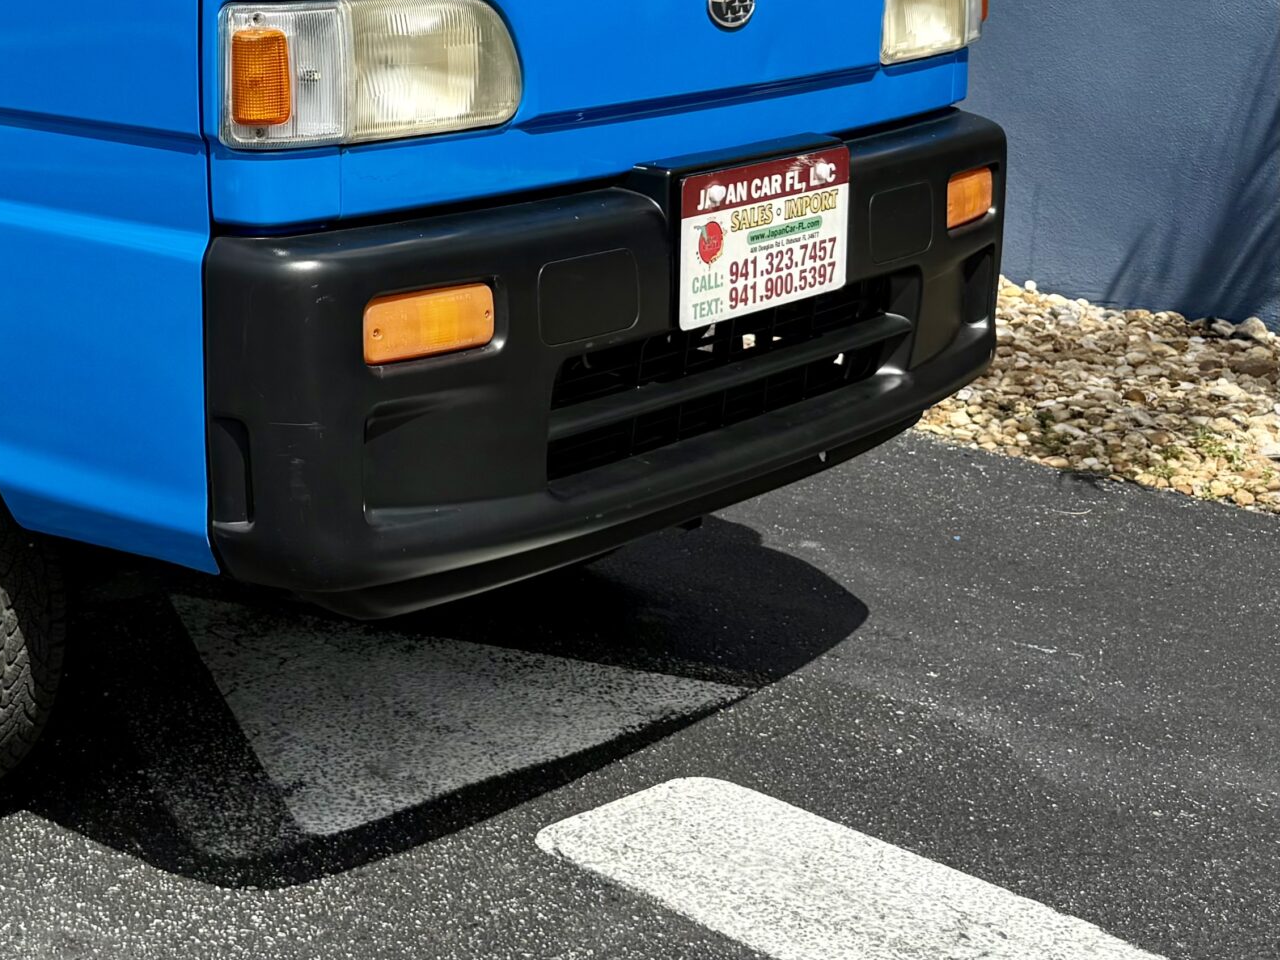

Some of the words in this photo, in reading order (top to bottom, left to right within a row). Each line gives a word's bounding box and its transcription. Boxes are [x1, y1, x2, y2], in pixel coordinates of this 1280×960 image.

[751, 174, 783, 199] CAR
[785, 171, 806, 193] FL,
[731, 203, 773, 232] SALES
[784, 189, 839, 221] IMPORT
[750, 219, 820, 242] www.JapanCar-FL.com
[692, 272, 724, 294] CALL:
[729, 236, 837, 285] 941.323.7457
[692, 298, 723, 320] TEXT:
[729, 261, 836, 310] 941.900.5397
